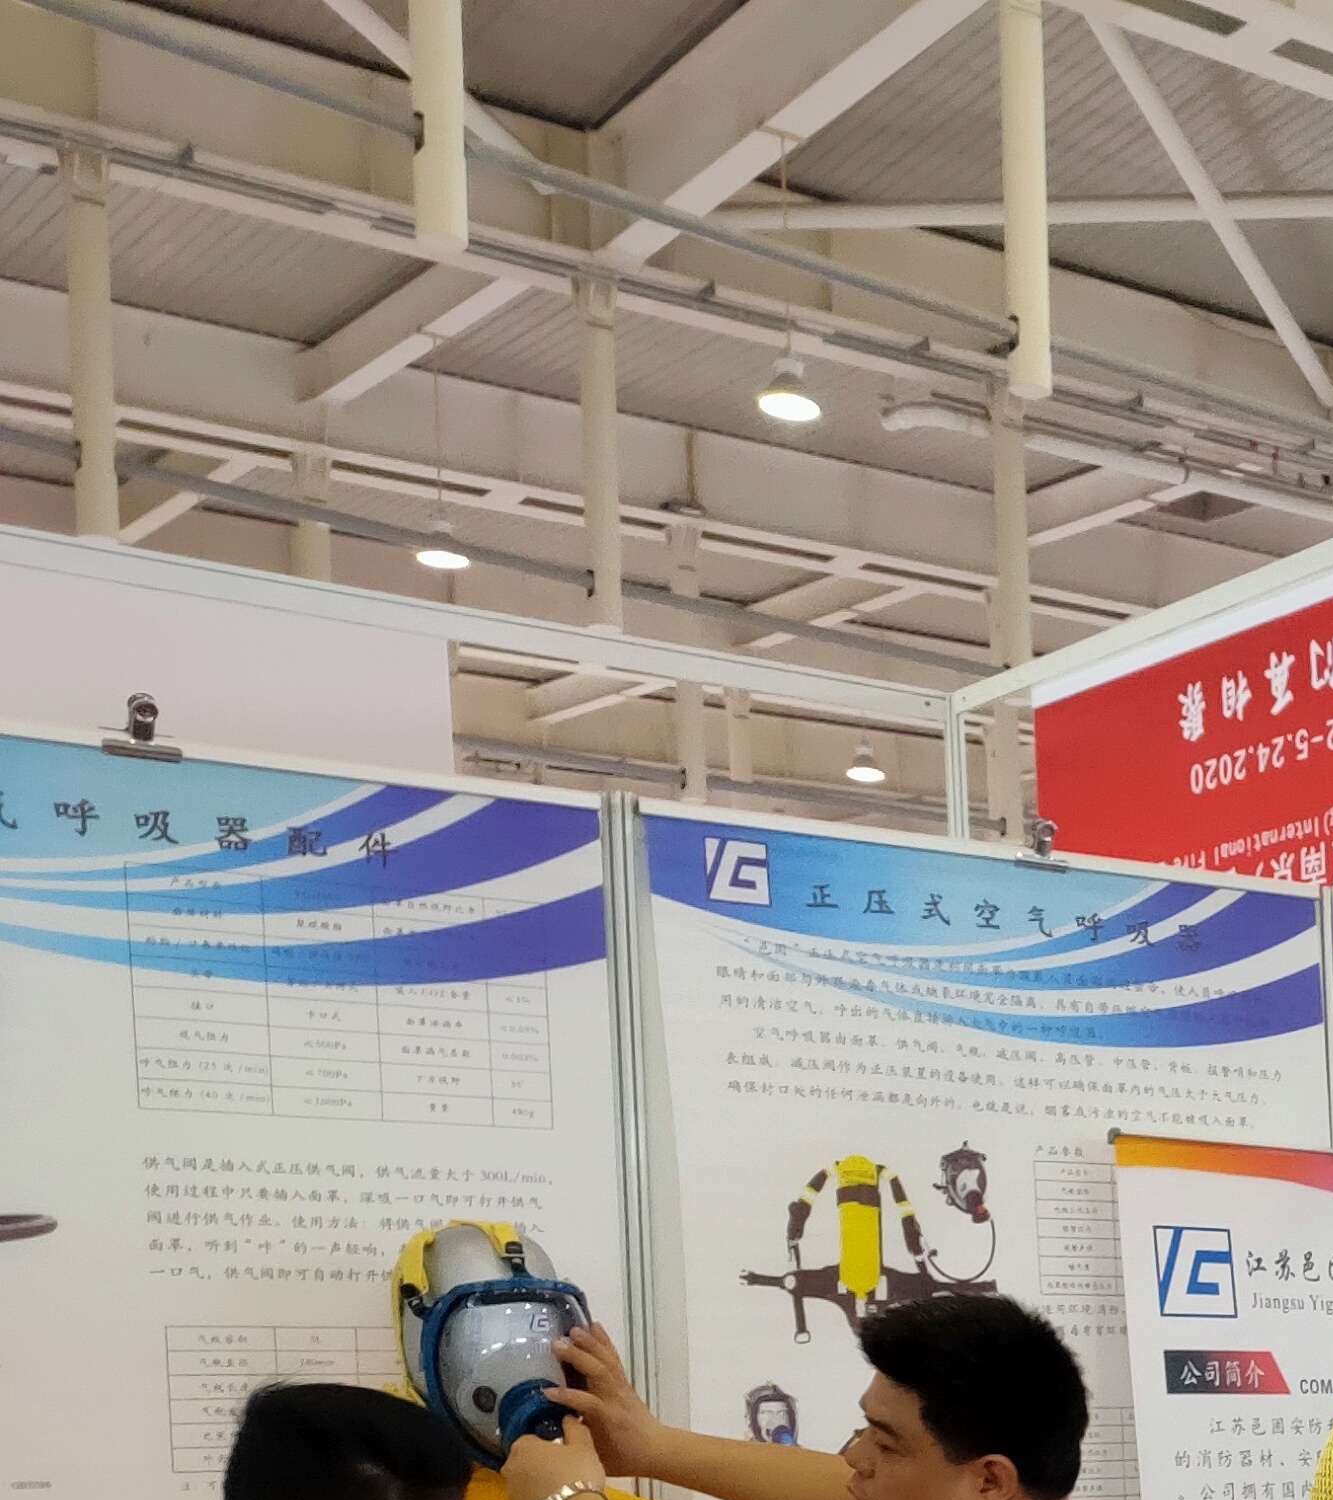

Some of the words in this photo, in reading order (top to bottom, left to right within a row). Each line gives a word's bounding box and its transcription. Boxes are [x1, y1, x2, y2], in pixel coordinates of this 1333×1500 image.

[805, 883, 1201, 953] 正压式空气呼吸器
[1251, 1292, 1305, 1313] Jiangsu
[1180, 1359, 1265, 1388] 公司简介
